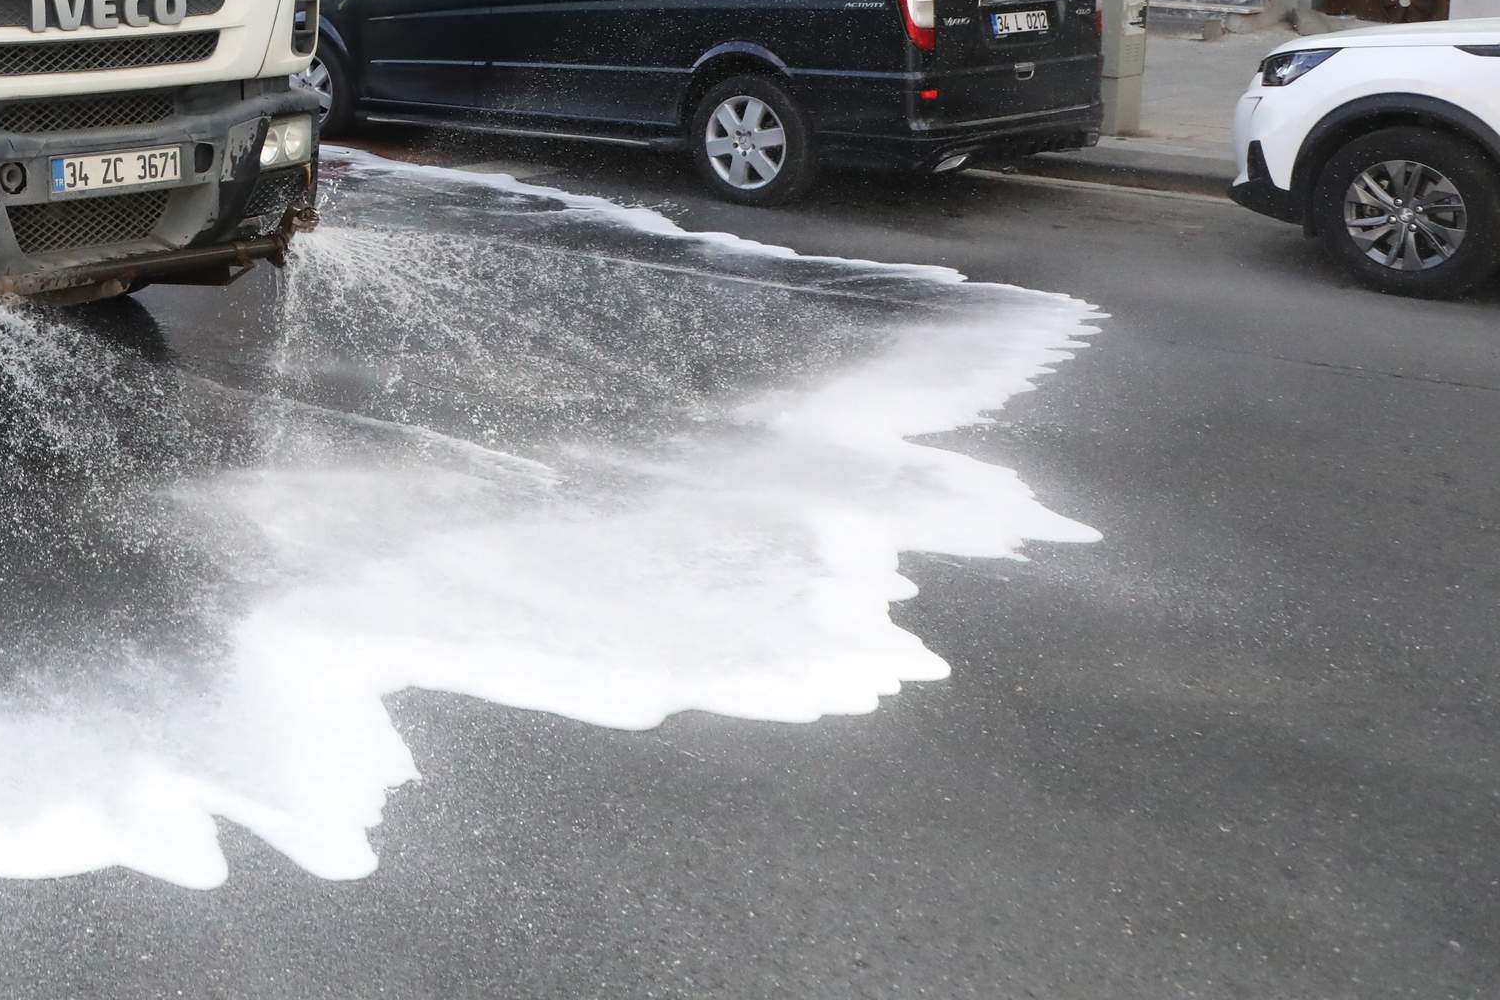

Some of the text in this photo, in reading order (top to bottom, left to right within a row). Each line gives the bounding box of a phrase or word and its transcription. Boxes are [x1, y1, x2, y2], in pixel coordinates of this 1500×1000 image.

[998, 15, 1010, 32] 34
[1015, 14, 1022, 30] L
[65, 151, 178, 188] 34 ZC 3671
